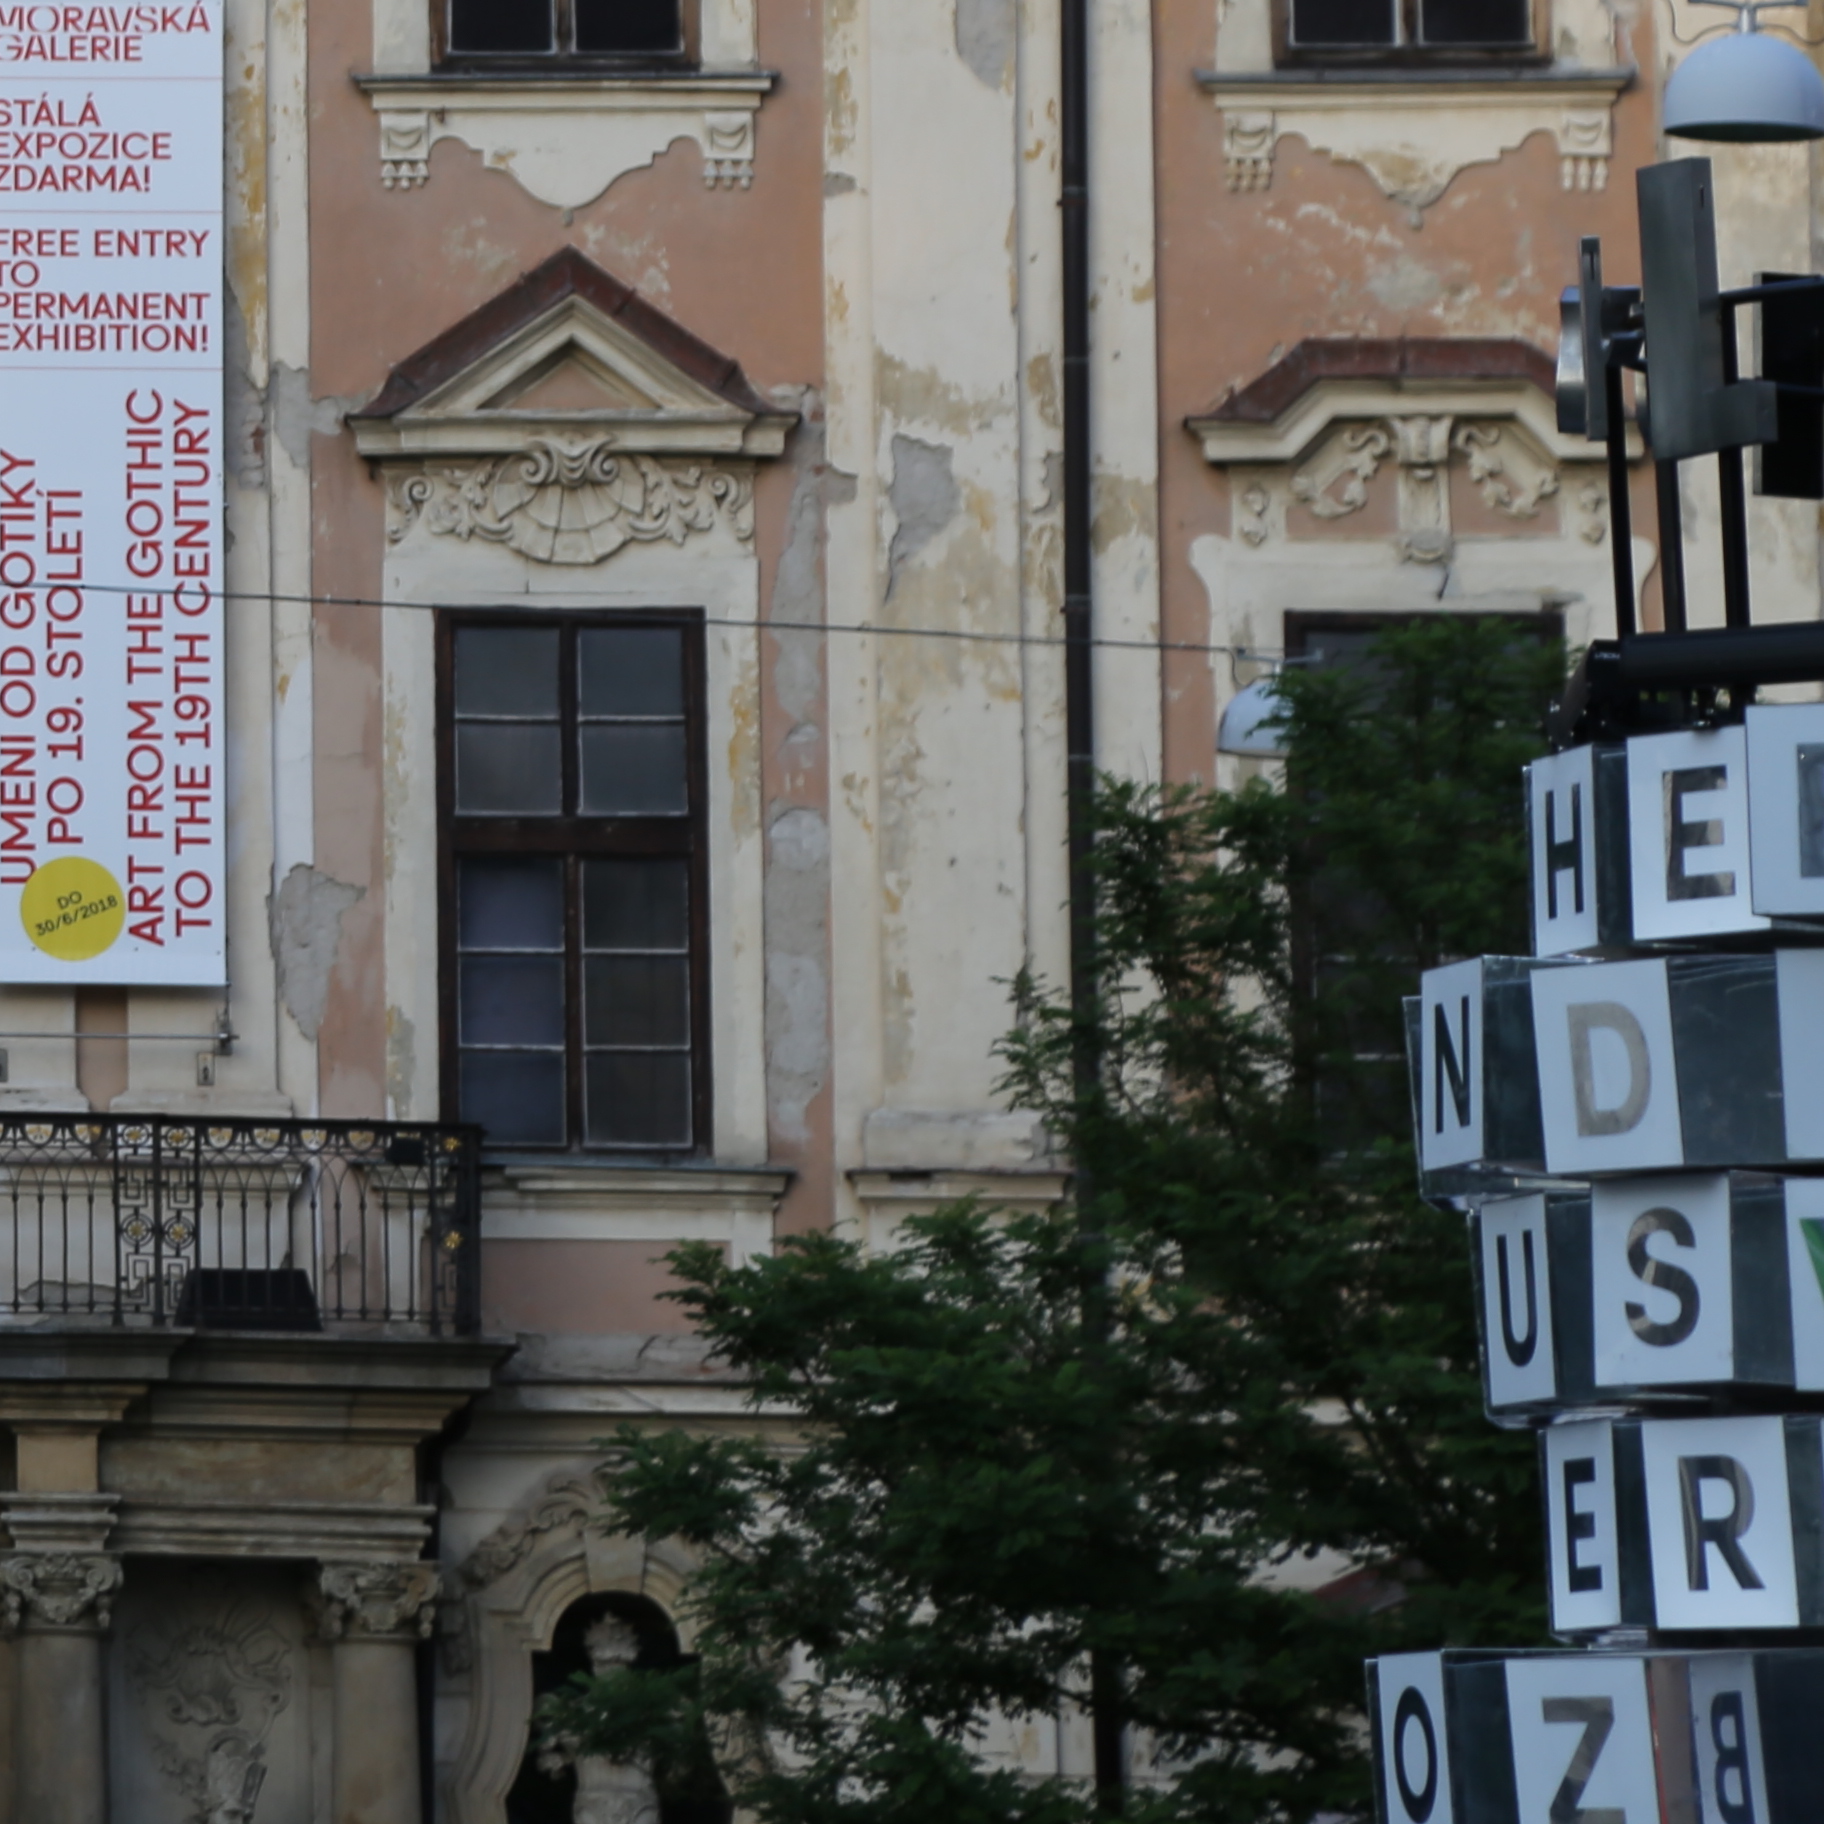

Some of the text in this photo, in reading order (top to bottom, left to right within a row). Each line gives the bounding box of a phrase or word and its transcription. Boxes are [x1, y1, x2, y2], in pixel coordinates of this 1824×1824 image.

[95, 231, 208, 256] ENTRY
[0, 646, 35, 717] OD
[36, 489, 84, 843] PO 19. STOLETÍ
[126, 390, 164, 945] ART FROM THE GOTHIC
[174, 398, 211, 937] TO THE 19TH CENTURY
[35, 894, 118, 937] 30/6/2018
[57, 891, 82, 910] DO
